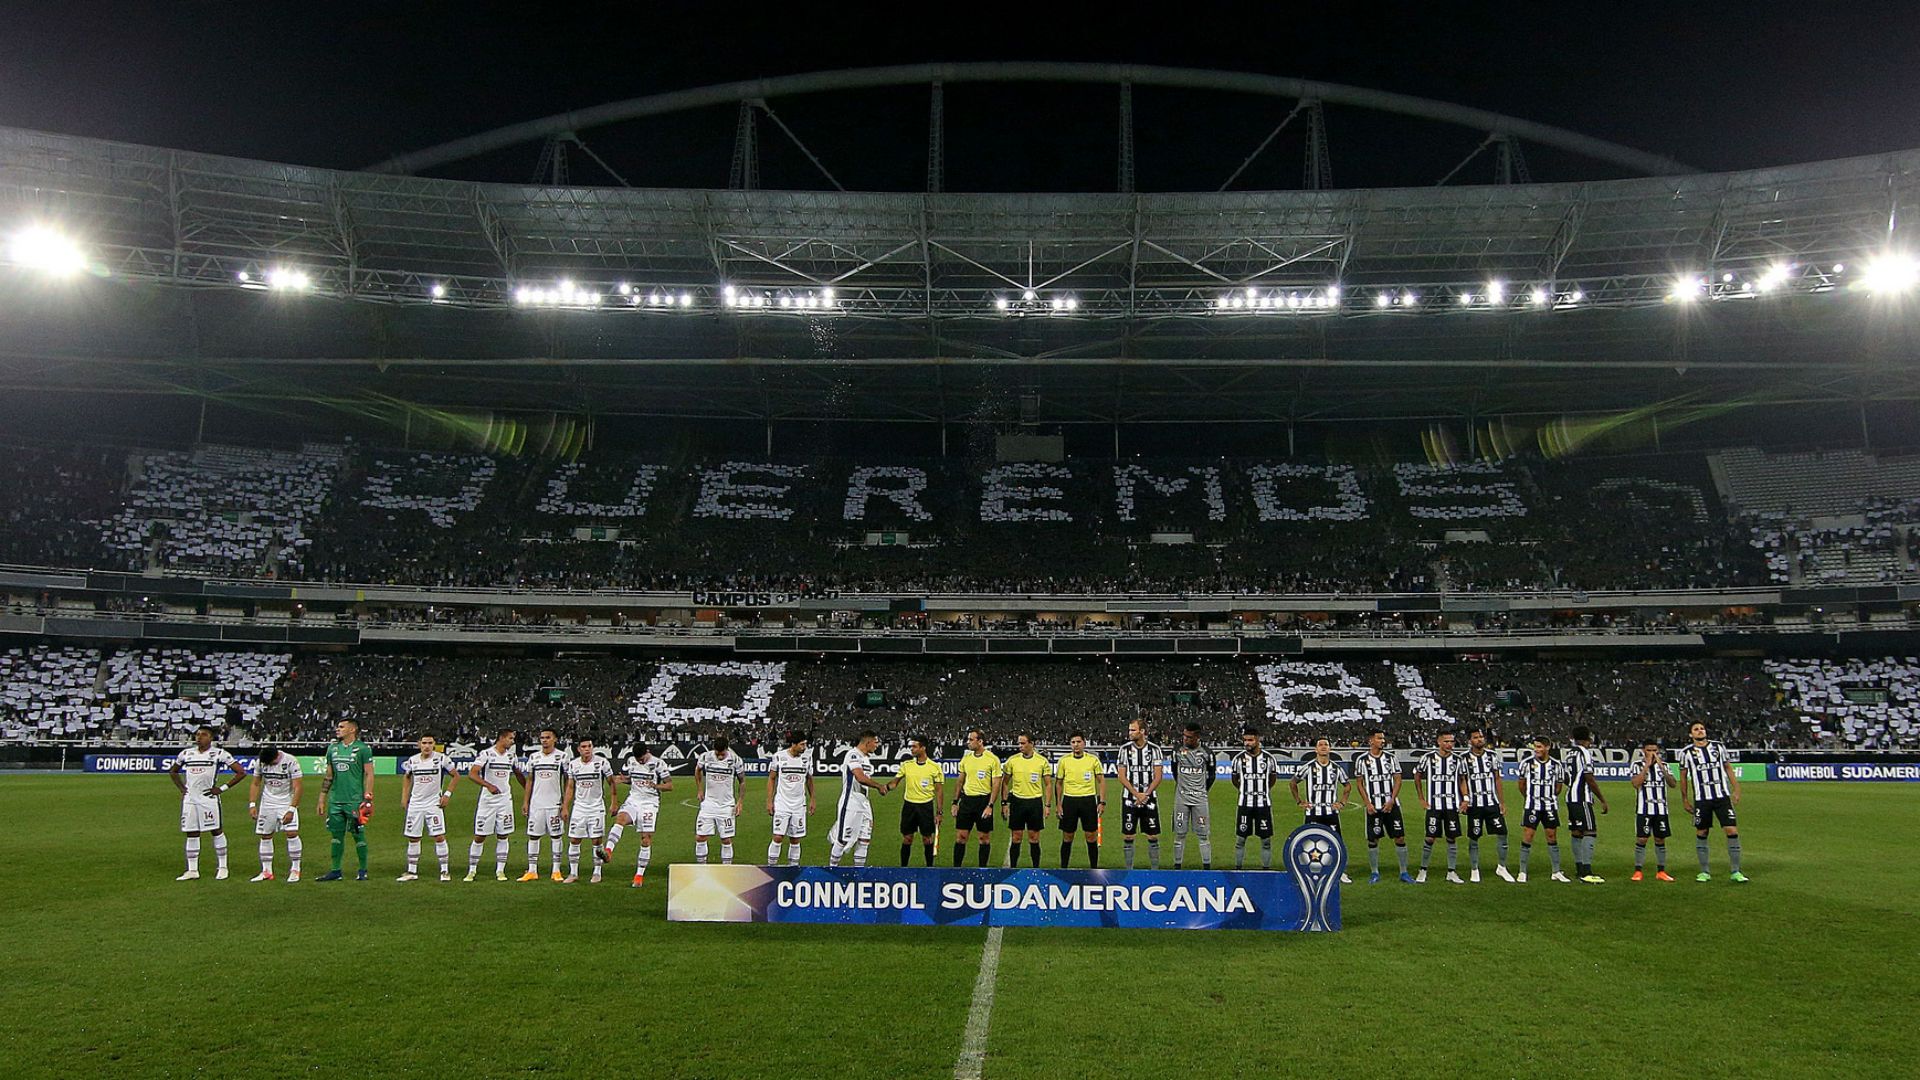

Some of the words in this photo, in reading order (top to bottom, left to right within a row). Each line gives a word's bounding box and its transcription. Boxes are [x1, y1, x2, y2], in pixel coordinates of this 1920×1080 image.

[693, 592, 771, 606] CAMPOS
[96, 758, 156, 770] CONMEBOL
[1697, 762, 1720, 771] CAIXA
[1471, 772, 1493, 780] CAIXA
[1777, 766, 1838, 779] CONMEBOL
[1369, 774, 1391, 782] CAIXA
[204, 811, 213, 820] 14
[643, 812, 653, 821] 22
[1177, 812, 1184, 821] 21
[1695, 808, 1701, 817] 2
[433, 816, 439, 825] 8
[504, 814, 512, 823] 23
[724, 818, 732, 827] 10
[1241, 815, 1247, 824] 11
[777, 880, 925, 910] CONMEBOL
[941, 882, 1256, 914] SUDAMERICANA
